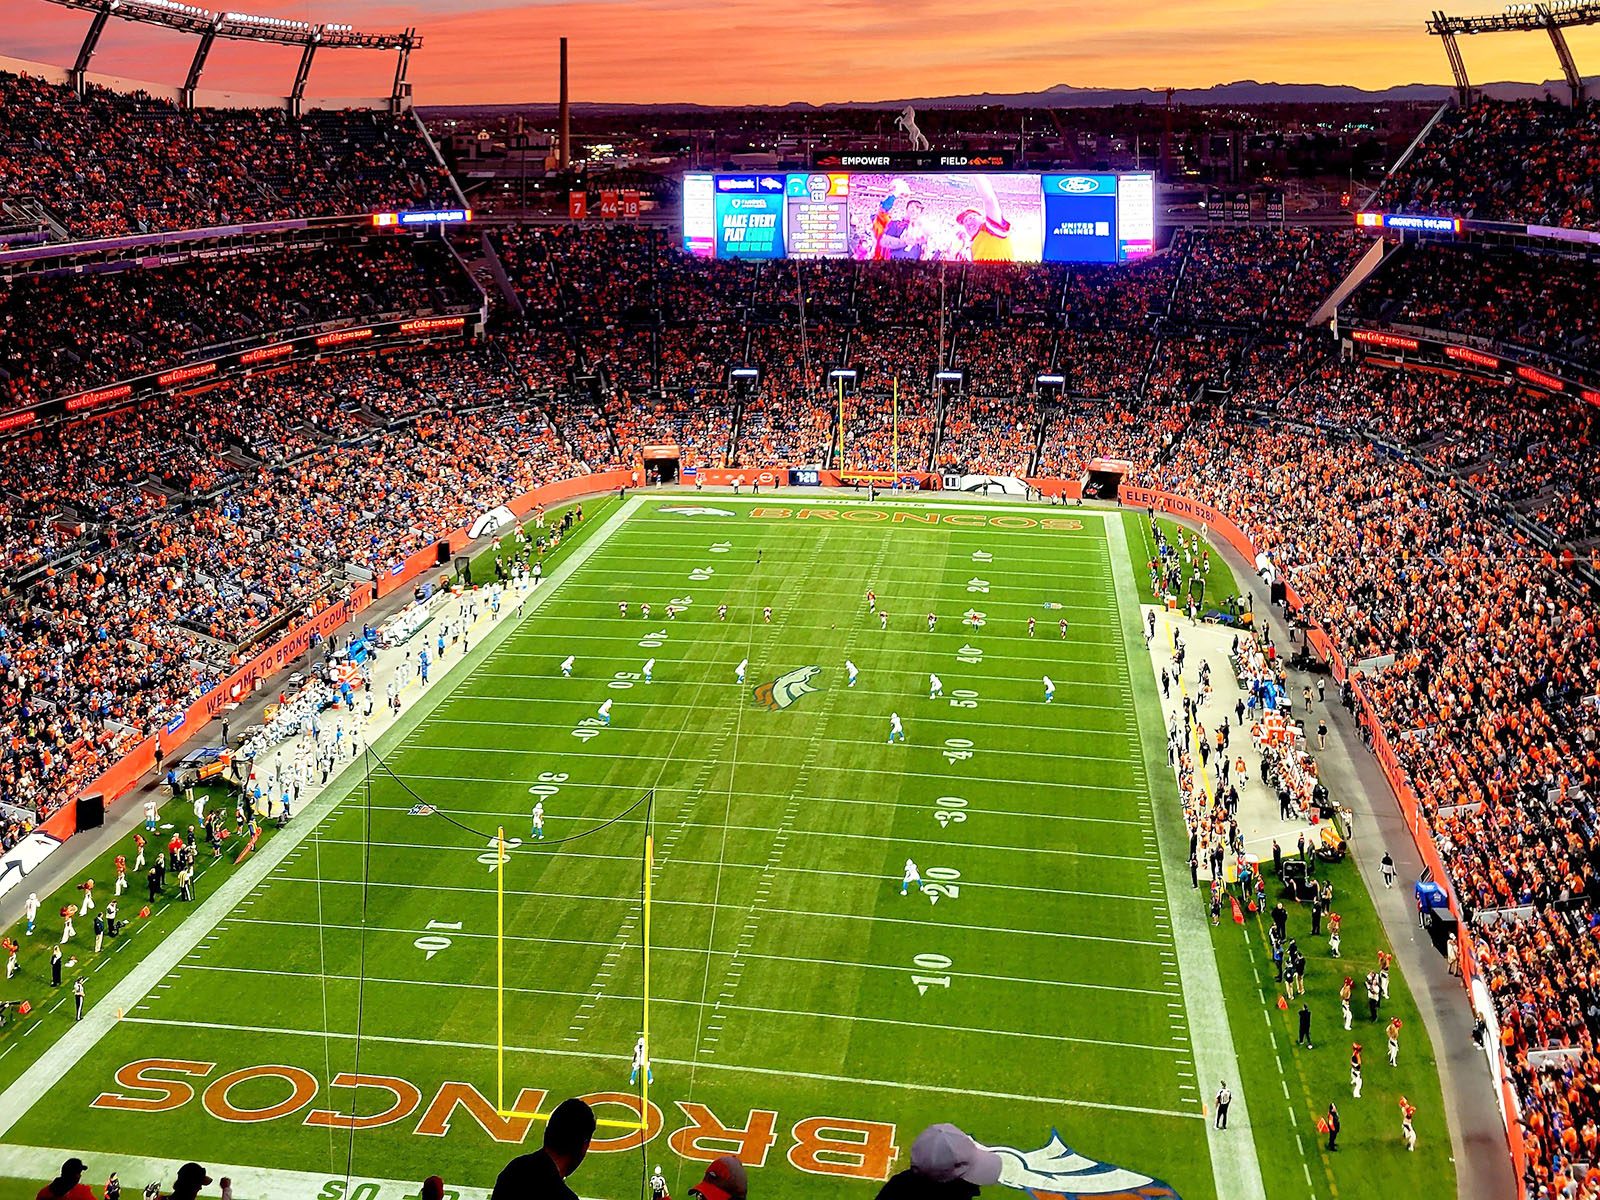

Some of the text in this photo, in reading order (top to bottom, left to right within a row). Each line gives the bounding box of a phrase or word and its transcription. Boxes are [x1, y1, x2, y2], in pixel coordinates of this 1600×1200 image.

[842, 157, 967, 166] EMPOWER FIELD
[574, 202, 581, 214] 7
[601, 202, 617, 213] 44
[625, 202, 637, 213] 18
[1208, 202, 1224, 210] 1997
[722, 214, 777, 228] MAKE EVERY
[724, 228, 747, 242] PLAY
[15, 412, 35, 424] SUGAR
[1126, 491, 1192, 513] ELEVTION
[749, 507, 1085, 531] BRONCOS
[966, 580, 990, 593] 20
[261, 656, 273, 674] TO
[323, 594, 364, 629] COURY
[956, 647, 984, 664] 40
[607, 672, 641, 689] 50
[950, 689, 979, 708] 50
[942, 738, 974, 760] 40
[528, 772, 569, 795] 30
[934, 796, 969, 823] 30
[923, 867, 961, 899] 20
[413, 919, 463, 951] 10
[911, 953, 953, 988] 10
[90, 1057, 899, 1181] BRONCOS
